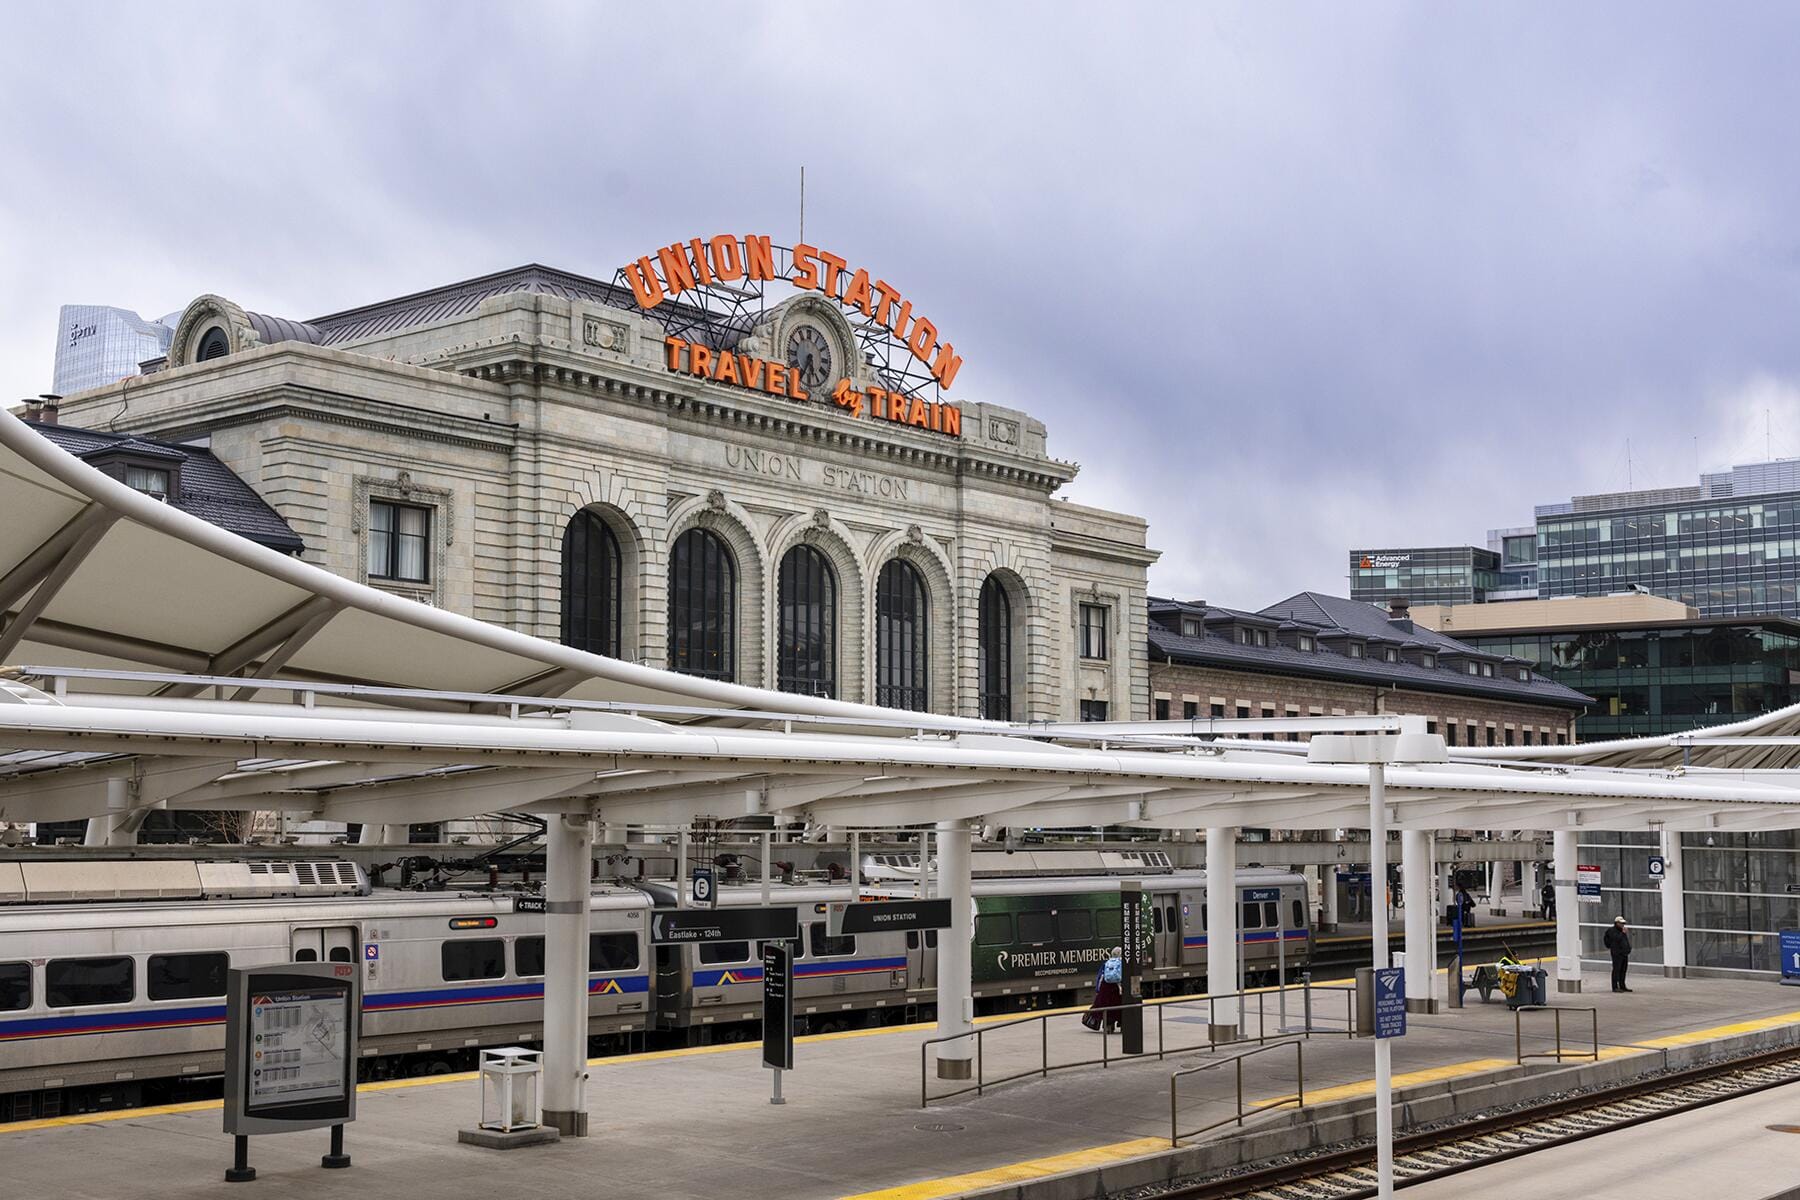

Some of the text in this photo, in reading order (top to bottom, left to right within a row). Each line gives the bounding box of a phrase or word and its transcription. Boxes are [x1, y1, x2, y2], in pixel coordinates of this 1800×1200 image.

[625, 234, 963, 390] UNION STATION
[665, 336, 961, 436] TRAVEL by TRAIN
[725, 445, 908, 500] UNION STATION
[1653, 863, 1659, 871] F
[699, 881, 705, 895] E
[1253, 891, 1268, 899] Denver
[873, 914, 891, 922] UNION
[668, 931, 697, 939] Eastlake
[1011, 947, 1111, 967] PREMIER MEMBERS
